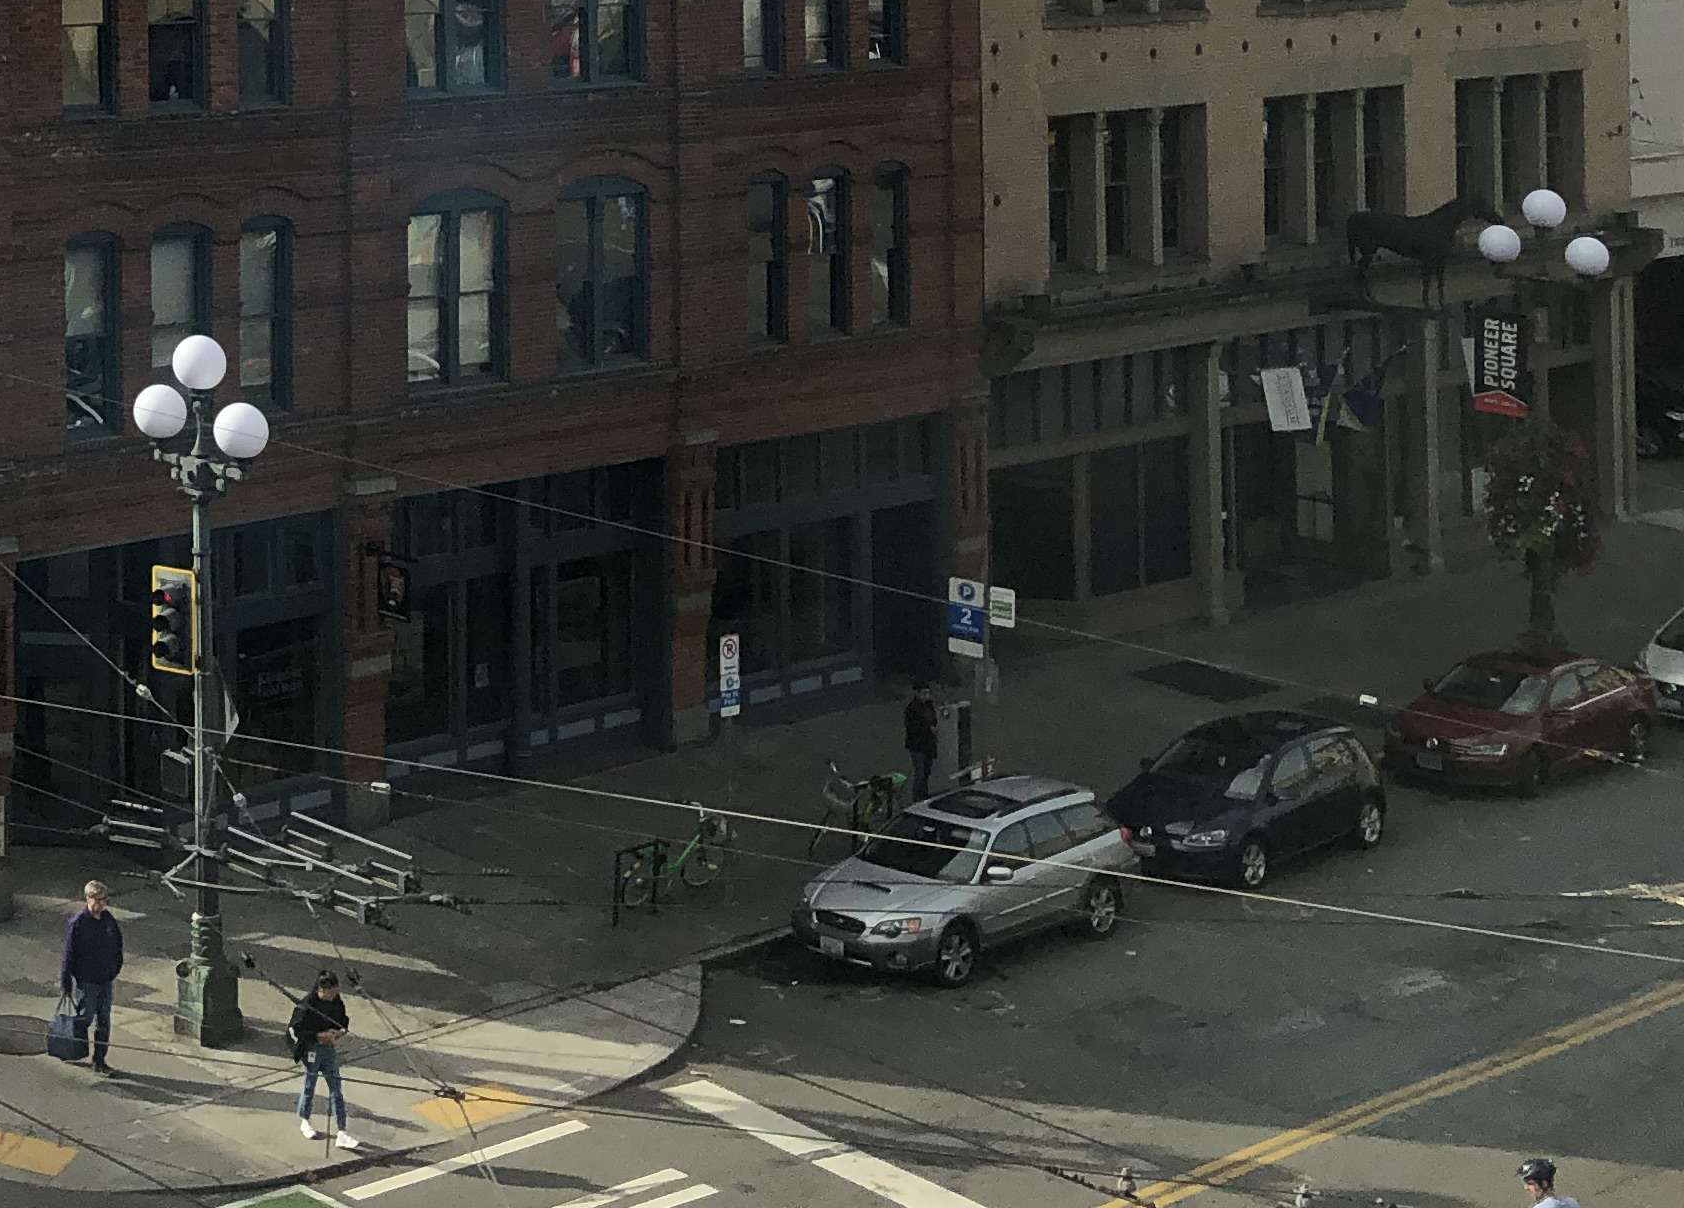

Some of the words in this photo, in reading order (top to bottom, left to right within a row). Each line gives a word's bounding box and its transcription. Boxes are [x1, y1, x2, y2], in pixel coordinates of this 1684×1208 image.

[1483, 317, 1500, 387] PIONEER
[1501, 321, 1518, 390] SQUARE
[960, 608, 972, 626] 2
